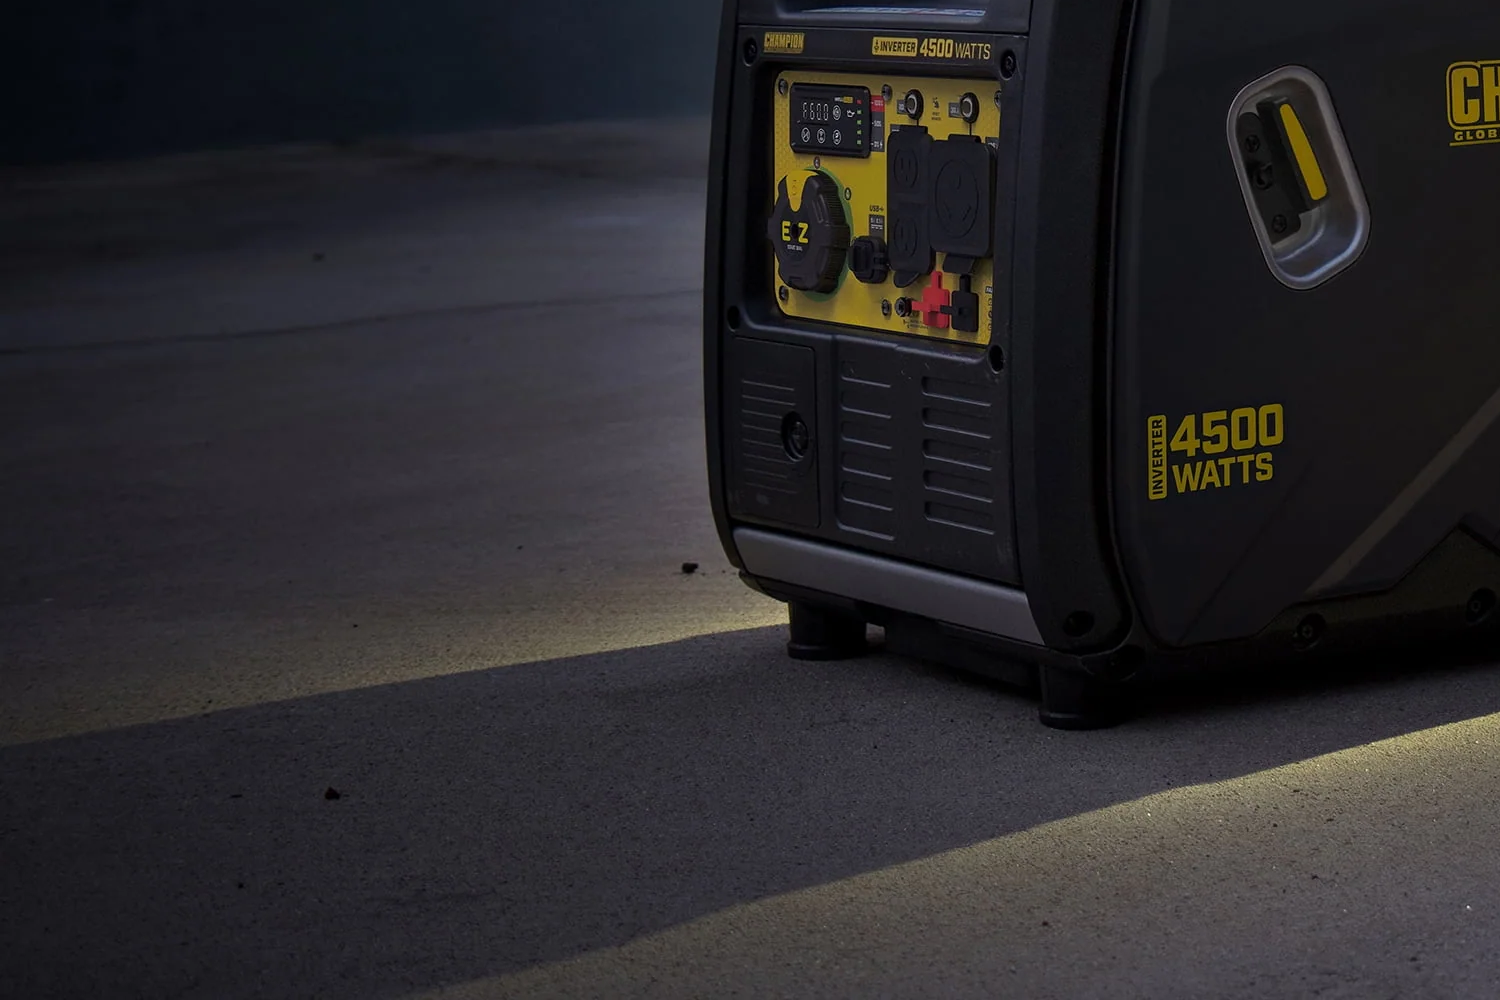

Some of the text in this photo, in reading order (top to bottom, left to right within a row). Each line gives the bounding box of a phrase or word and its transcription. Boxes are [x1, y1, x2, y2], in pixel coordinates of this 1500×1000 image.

[765, 32, 804, 53] CHAMPION
[881, 38, 991, 60] INVERTER 4500 WATTS
[1169, 402, 1285, 458] 4500
[1152, 418, 1163, 496] INVERTER
[1171, 451, 1274, 494] WATTS
